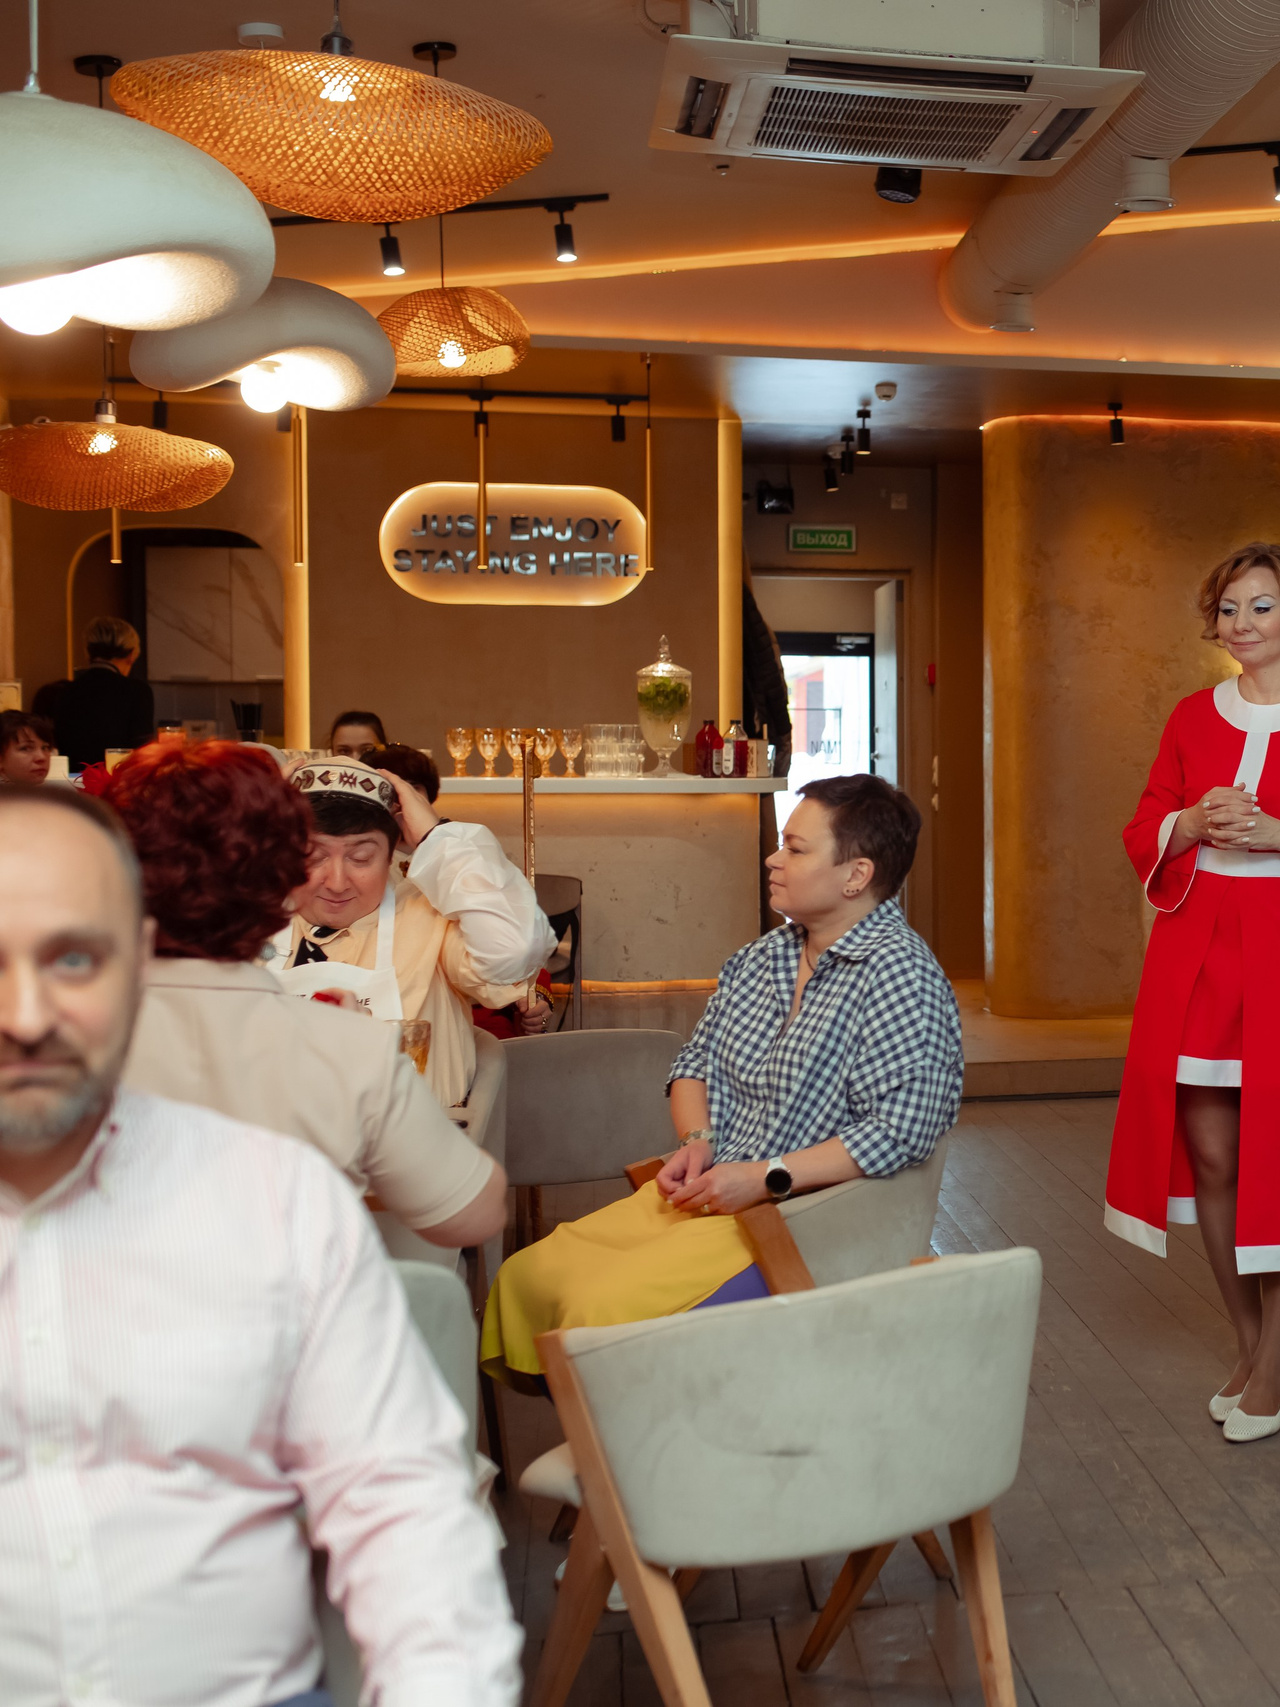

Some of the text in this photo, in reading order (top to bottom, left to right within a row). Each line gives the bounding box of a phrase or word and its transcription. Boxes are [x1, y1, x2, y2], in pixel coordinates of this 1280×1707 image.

[411, 513, 622, 542] JUST ENJOY
[796, 532, 848, 547] ВЫХОД
[393, 548, 640, 577] STAYNG HERE
